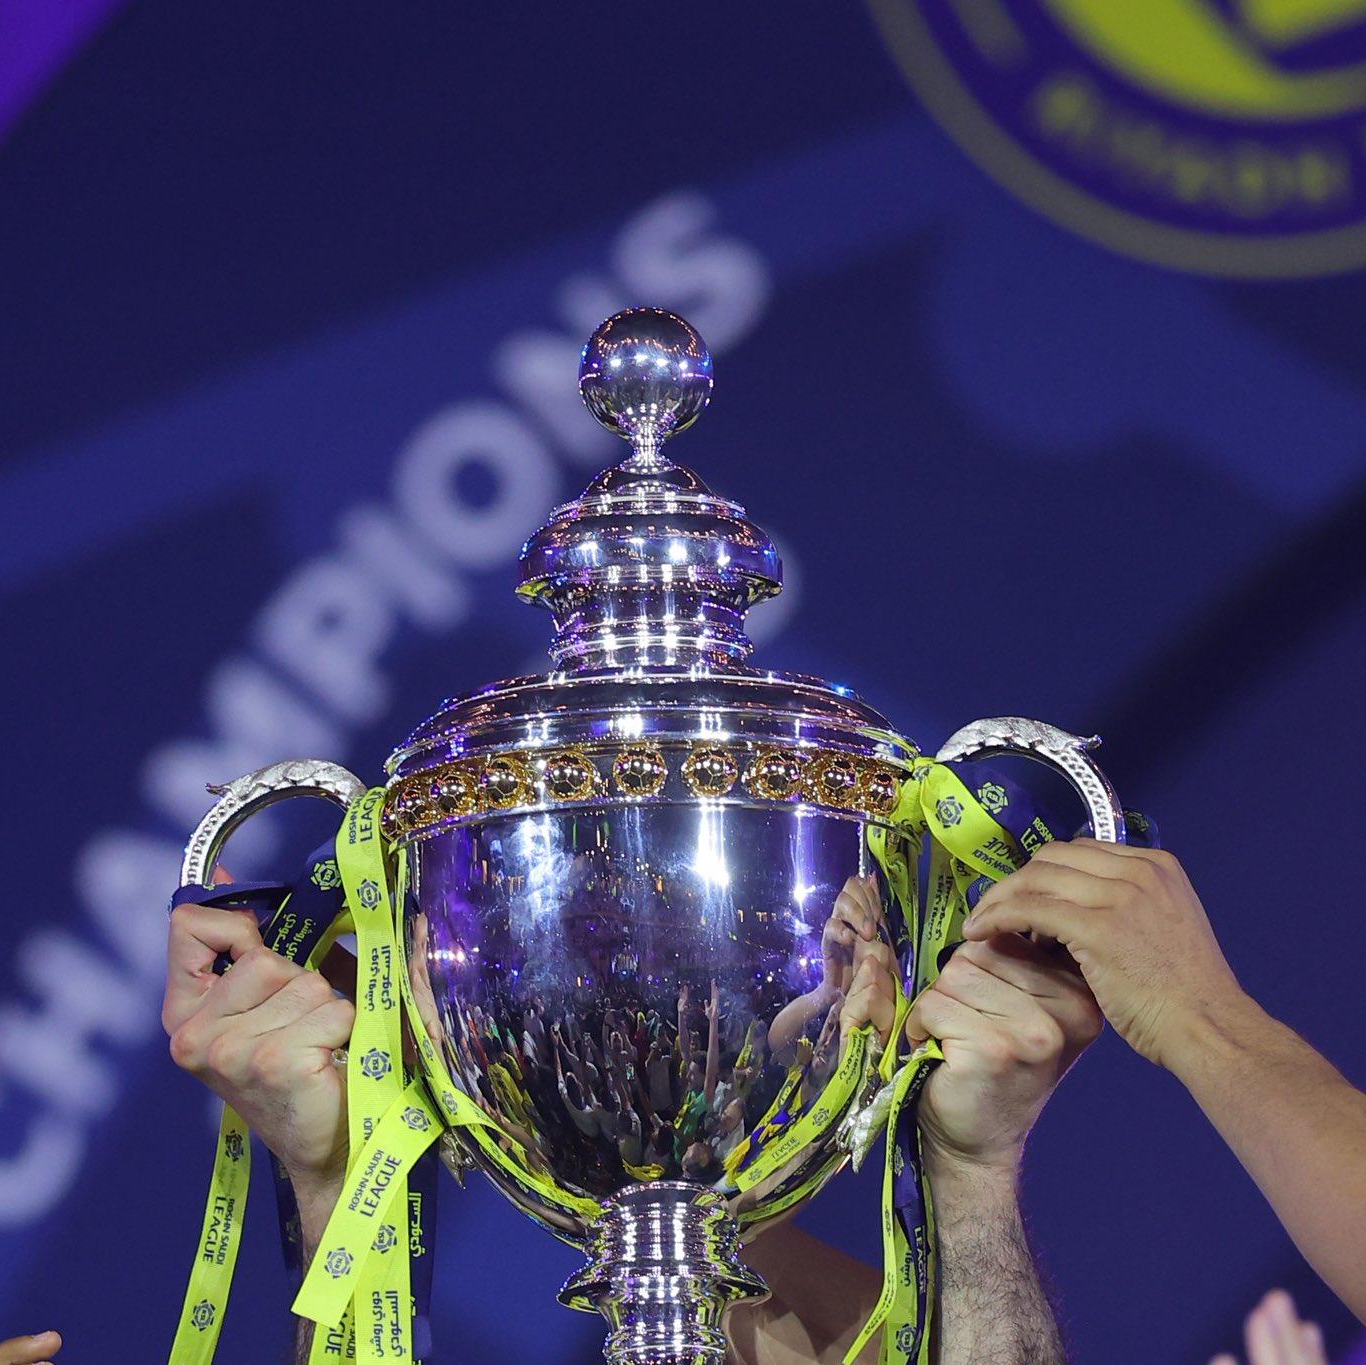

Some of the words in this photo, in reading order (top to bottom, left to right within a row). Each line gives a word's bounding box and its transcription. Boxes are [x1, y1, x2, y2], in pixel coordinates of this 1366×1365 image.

[1020, 828, 1043, 857] LEA
[381, 945, 396, 1010] السعودي
[348, 1178, 369, 1211] ROSHN
[365, 1149, 385, 1176] SAUDI
[360, 1155, 402, 1217] LEAGUE
[203, 1196, 226, 1263] LEAGUE
[223, 1199, 235, 1234] ROSHN
[408, 1192, 426, 1257] السعودي
[217, 1235, 229, 1265] SAUDI
[372, 1291, 385, 1321] دوري
[385, 1290, 406, 1357] السعودي
[370, 1324, 384, 1357] روشن
